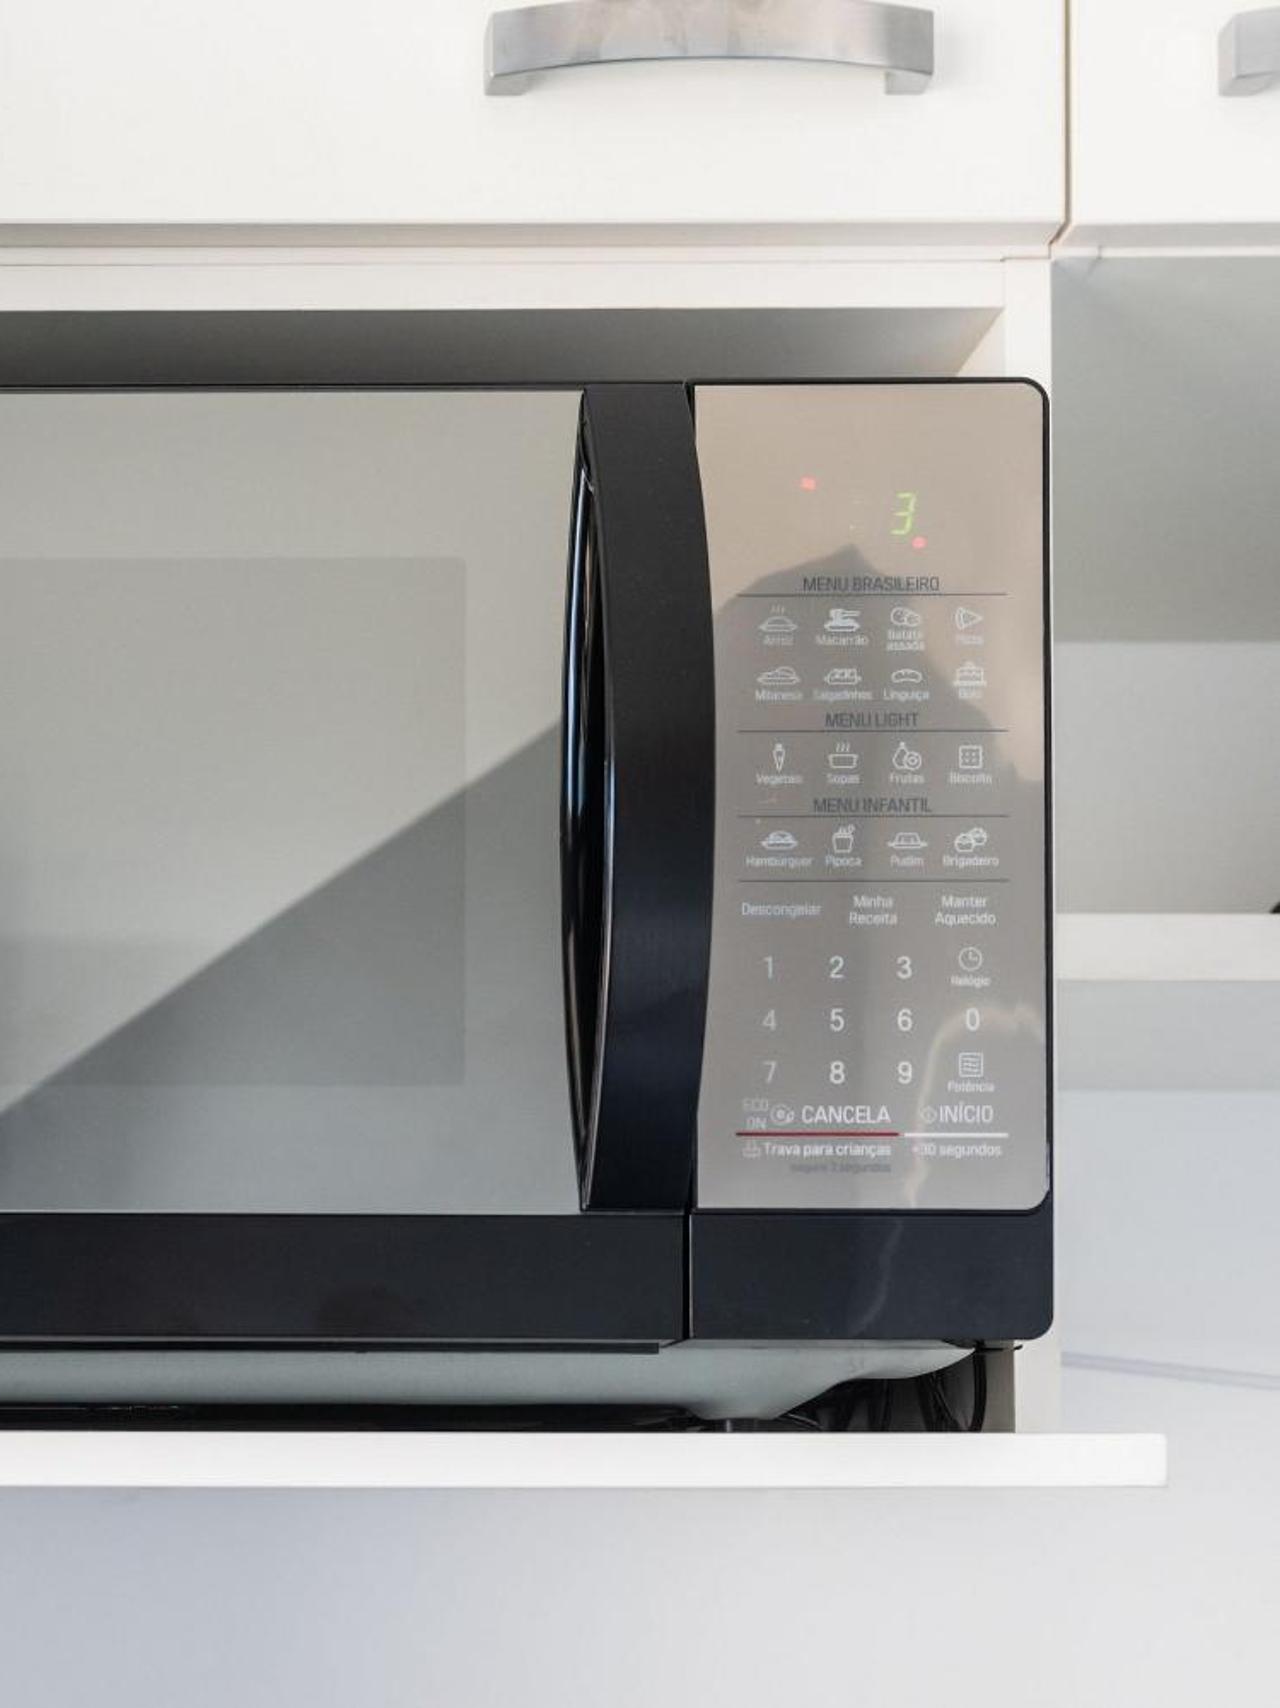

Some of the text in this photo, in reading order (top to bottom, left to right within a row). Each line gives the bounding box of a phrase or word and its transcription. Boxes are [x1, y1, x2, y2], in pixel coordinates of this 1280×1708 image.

[890, 492, 917, 535] 3
[803, 576, 941, 592] MENU BRASILEIRO
[825, 712, 920, 728] MENU LIGHT
[813, 797, 932, 813] MENU INFANTIL
[741, 901, 824, 920] Descongelar
[853, 895, 895, 909] Minha
[941, 895, 988, 908] Manter
[849, 911, 899, 926] Receita
[935, 911, 997, 927] Aquecido
[761, 955, 775, 980] 1
[828, 955, 847, 980] 2
[895, 955, 914, 980] 3
[761, 1008, 779, 1033] 4
[829, 1007, 846, 1033] 5
[896, 1007, 914, 1033] 6
[965, 1007, 981, 1032] 0
[762, 1060, 778, 1084] 7
[828, 1060, 847, 1085] 8
[896, 1060, 914, 1085] 9
[801, 1104, 892, 1124] CANCELA
[939, 1101, 995, 1123] INÍCIO
[764, 1142, 892, 1159] Trava para crianças
[939, 1143, 1002, 1159] segundos
